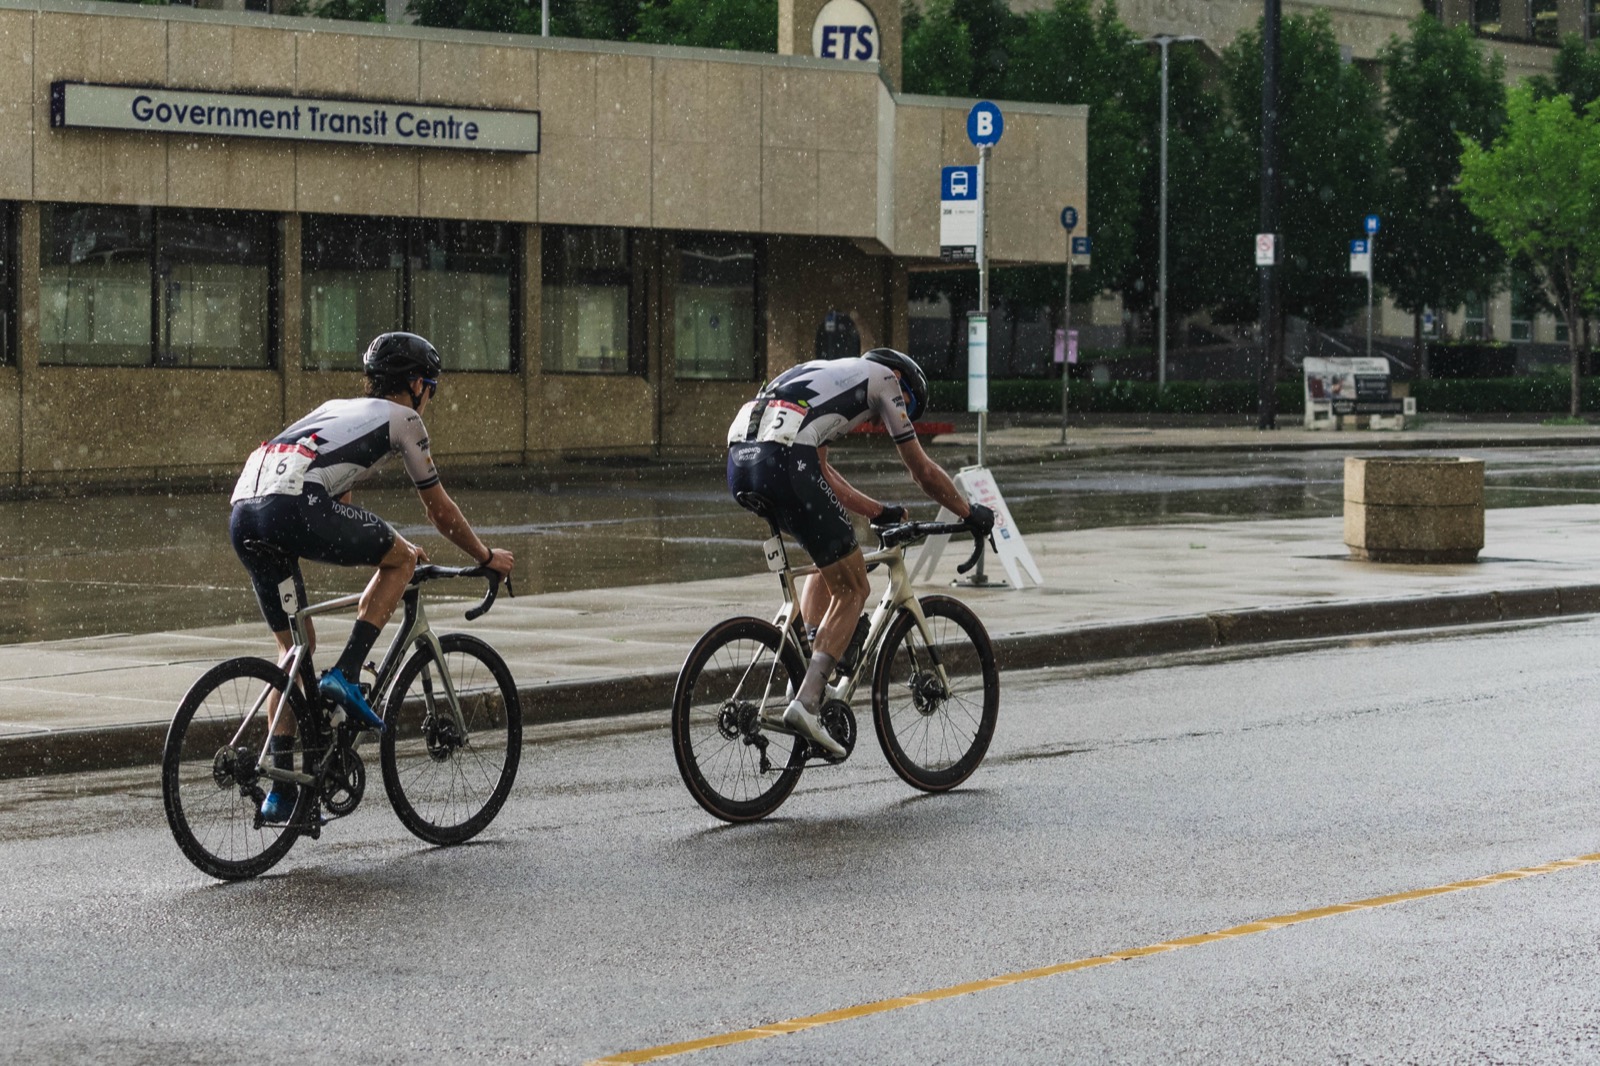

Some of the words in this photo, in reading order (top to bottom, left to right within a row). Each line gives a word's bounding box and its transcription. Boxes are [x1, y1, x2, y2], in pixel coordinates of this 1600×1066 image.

[821, 25, 873, 60] ETS
[131, 95, 302, 130] Government
[308, 106, 388, 136] Transit
[395, 111, 479, 140] Centre
[977, 111, 993, 136] B
[772, 410, 787, 429] 5
[276, 455, 290, 476] 6
[817, 474, 853, 525] TORONTO
[331, 500, 379, 524] TORONTO
[767, 549, 780, 561] 5
[283, 593, 293, 603] 6
